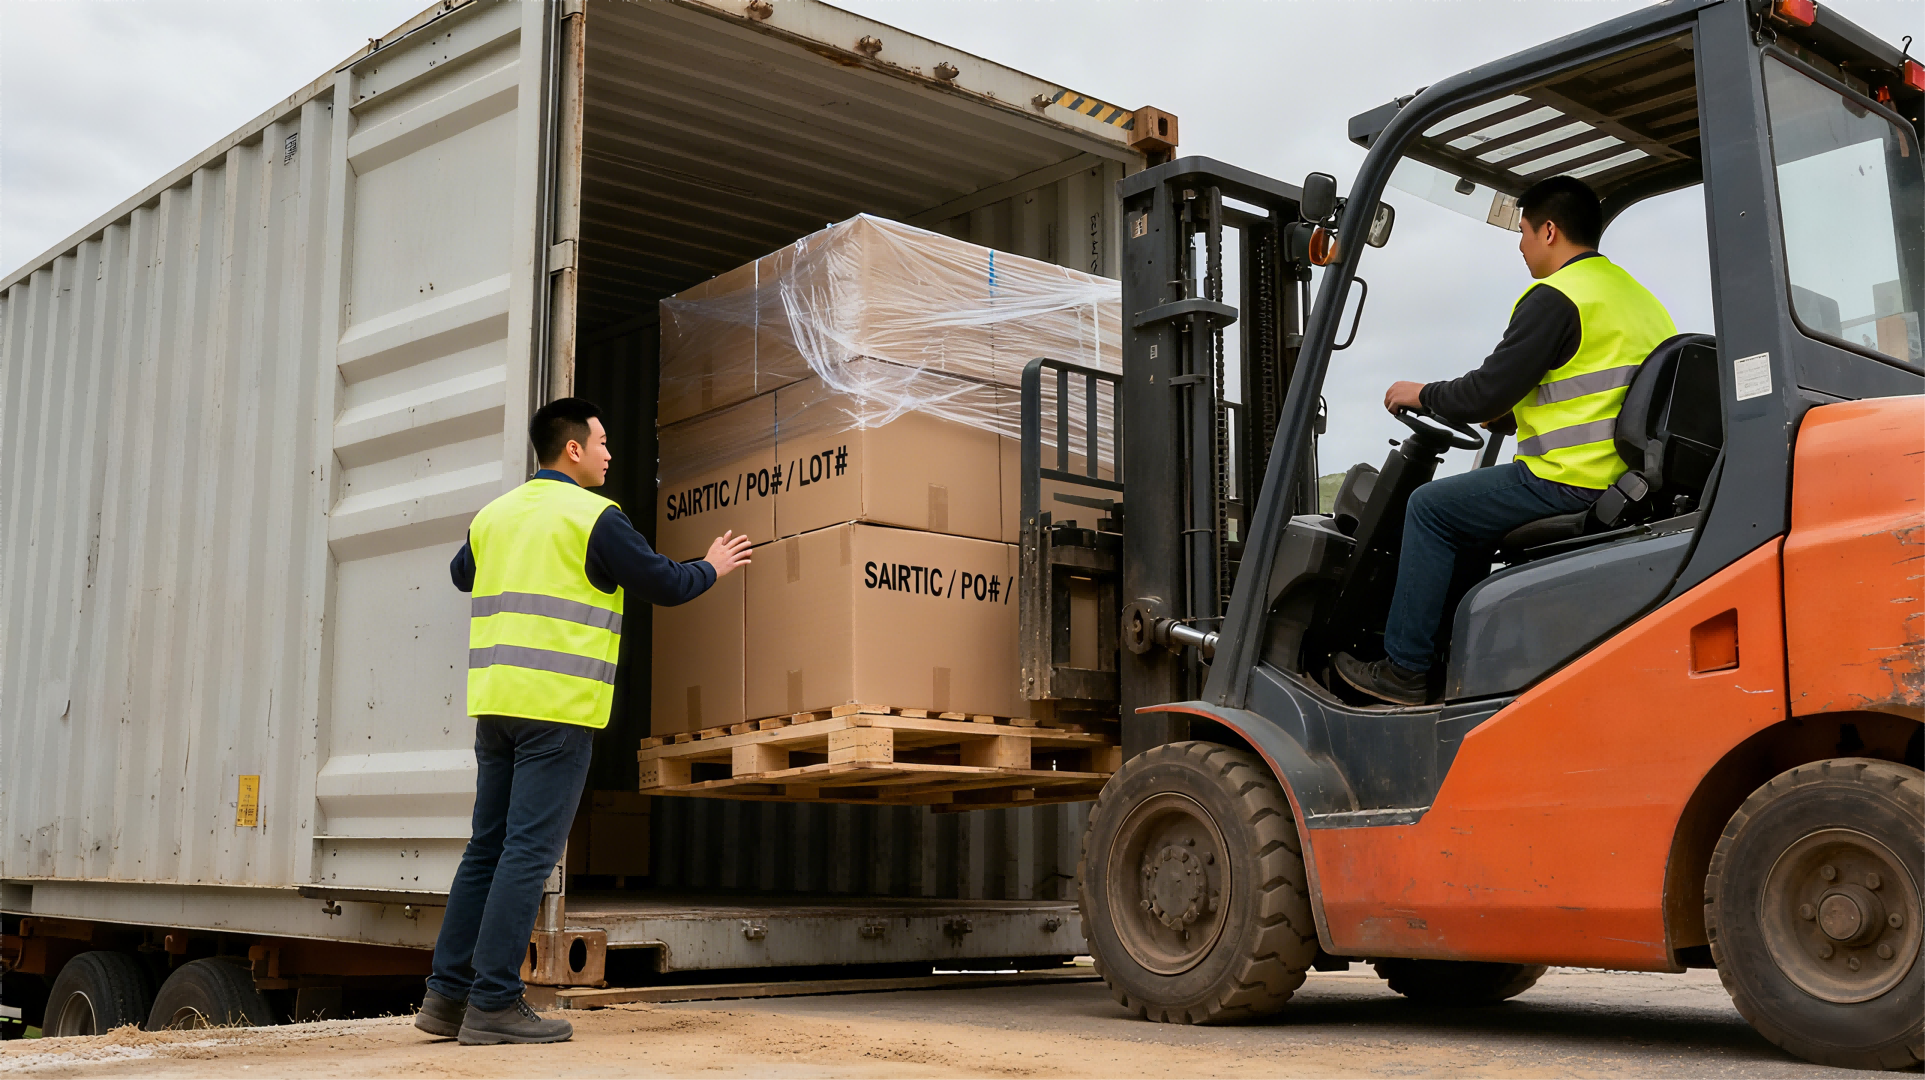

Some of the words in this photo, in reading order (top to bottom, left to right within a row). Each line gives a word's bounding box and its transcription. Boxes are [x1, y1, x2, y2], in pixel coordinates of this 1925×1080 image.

[666, 479, 731, 521] SAIRTIC
[746, 464, 783, 502] PO#
[799, 445, 848, 487] LOT#
[864, 561, 943, 597] SAIRTIC
[961, 571, 1001, 603] PO#
